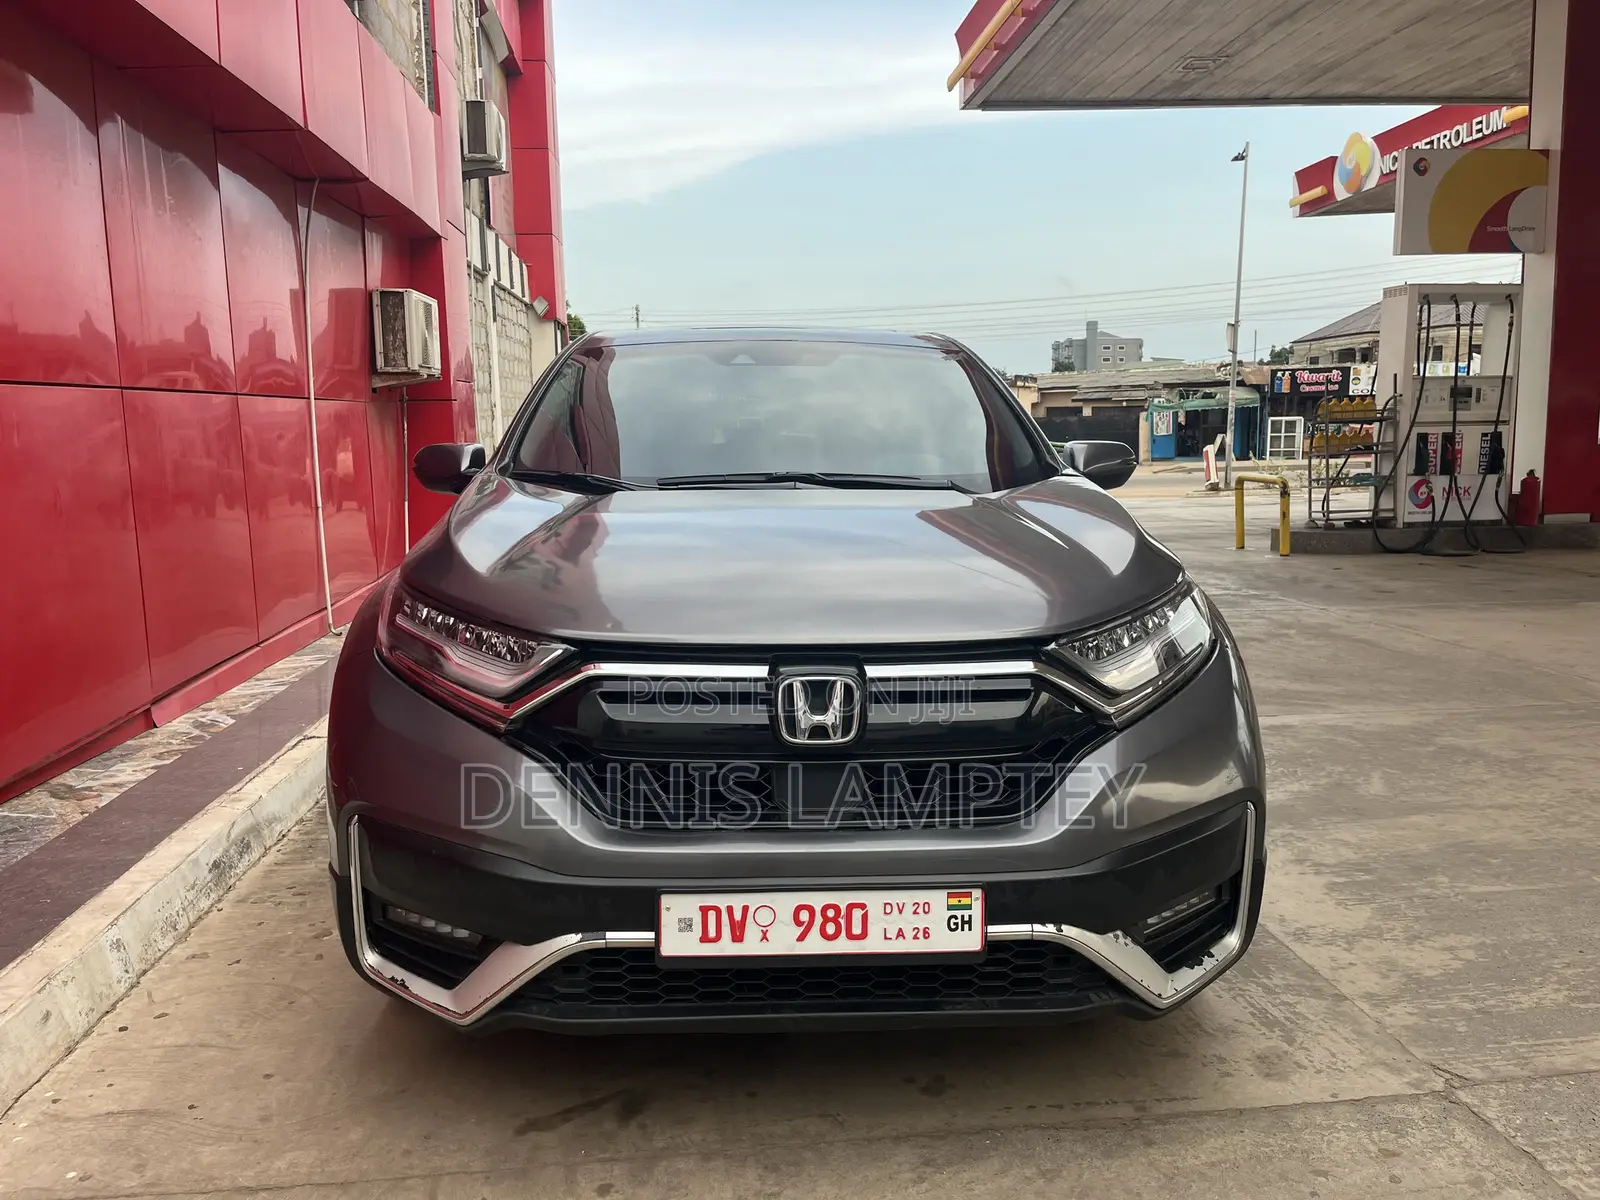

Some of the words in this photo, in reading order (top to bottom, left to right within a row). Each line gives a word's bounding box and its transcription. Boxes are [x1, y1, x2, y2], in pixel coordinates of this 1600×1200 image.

[1379, 147, 1408, 175] NIC
[883, 902, 905, 915] DV
[912, 901, 931, 915] 20
[699, 904, 749, 943] DV
[793, 902, 868, 942] 980
[947, 914, 973, 932] GH
[883, 927, 906, 940] LA
[912, 926, 931, 940] 26
